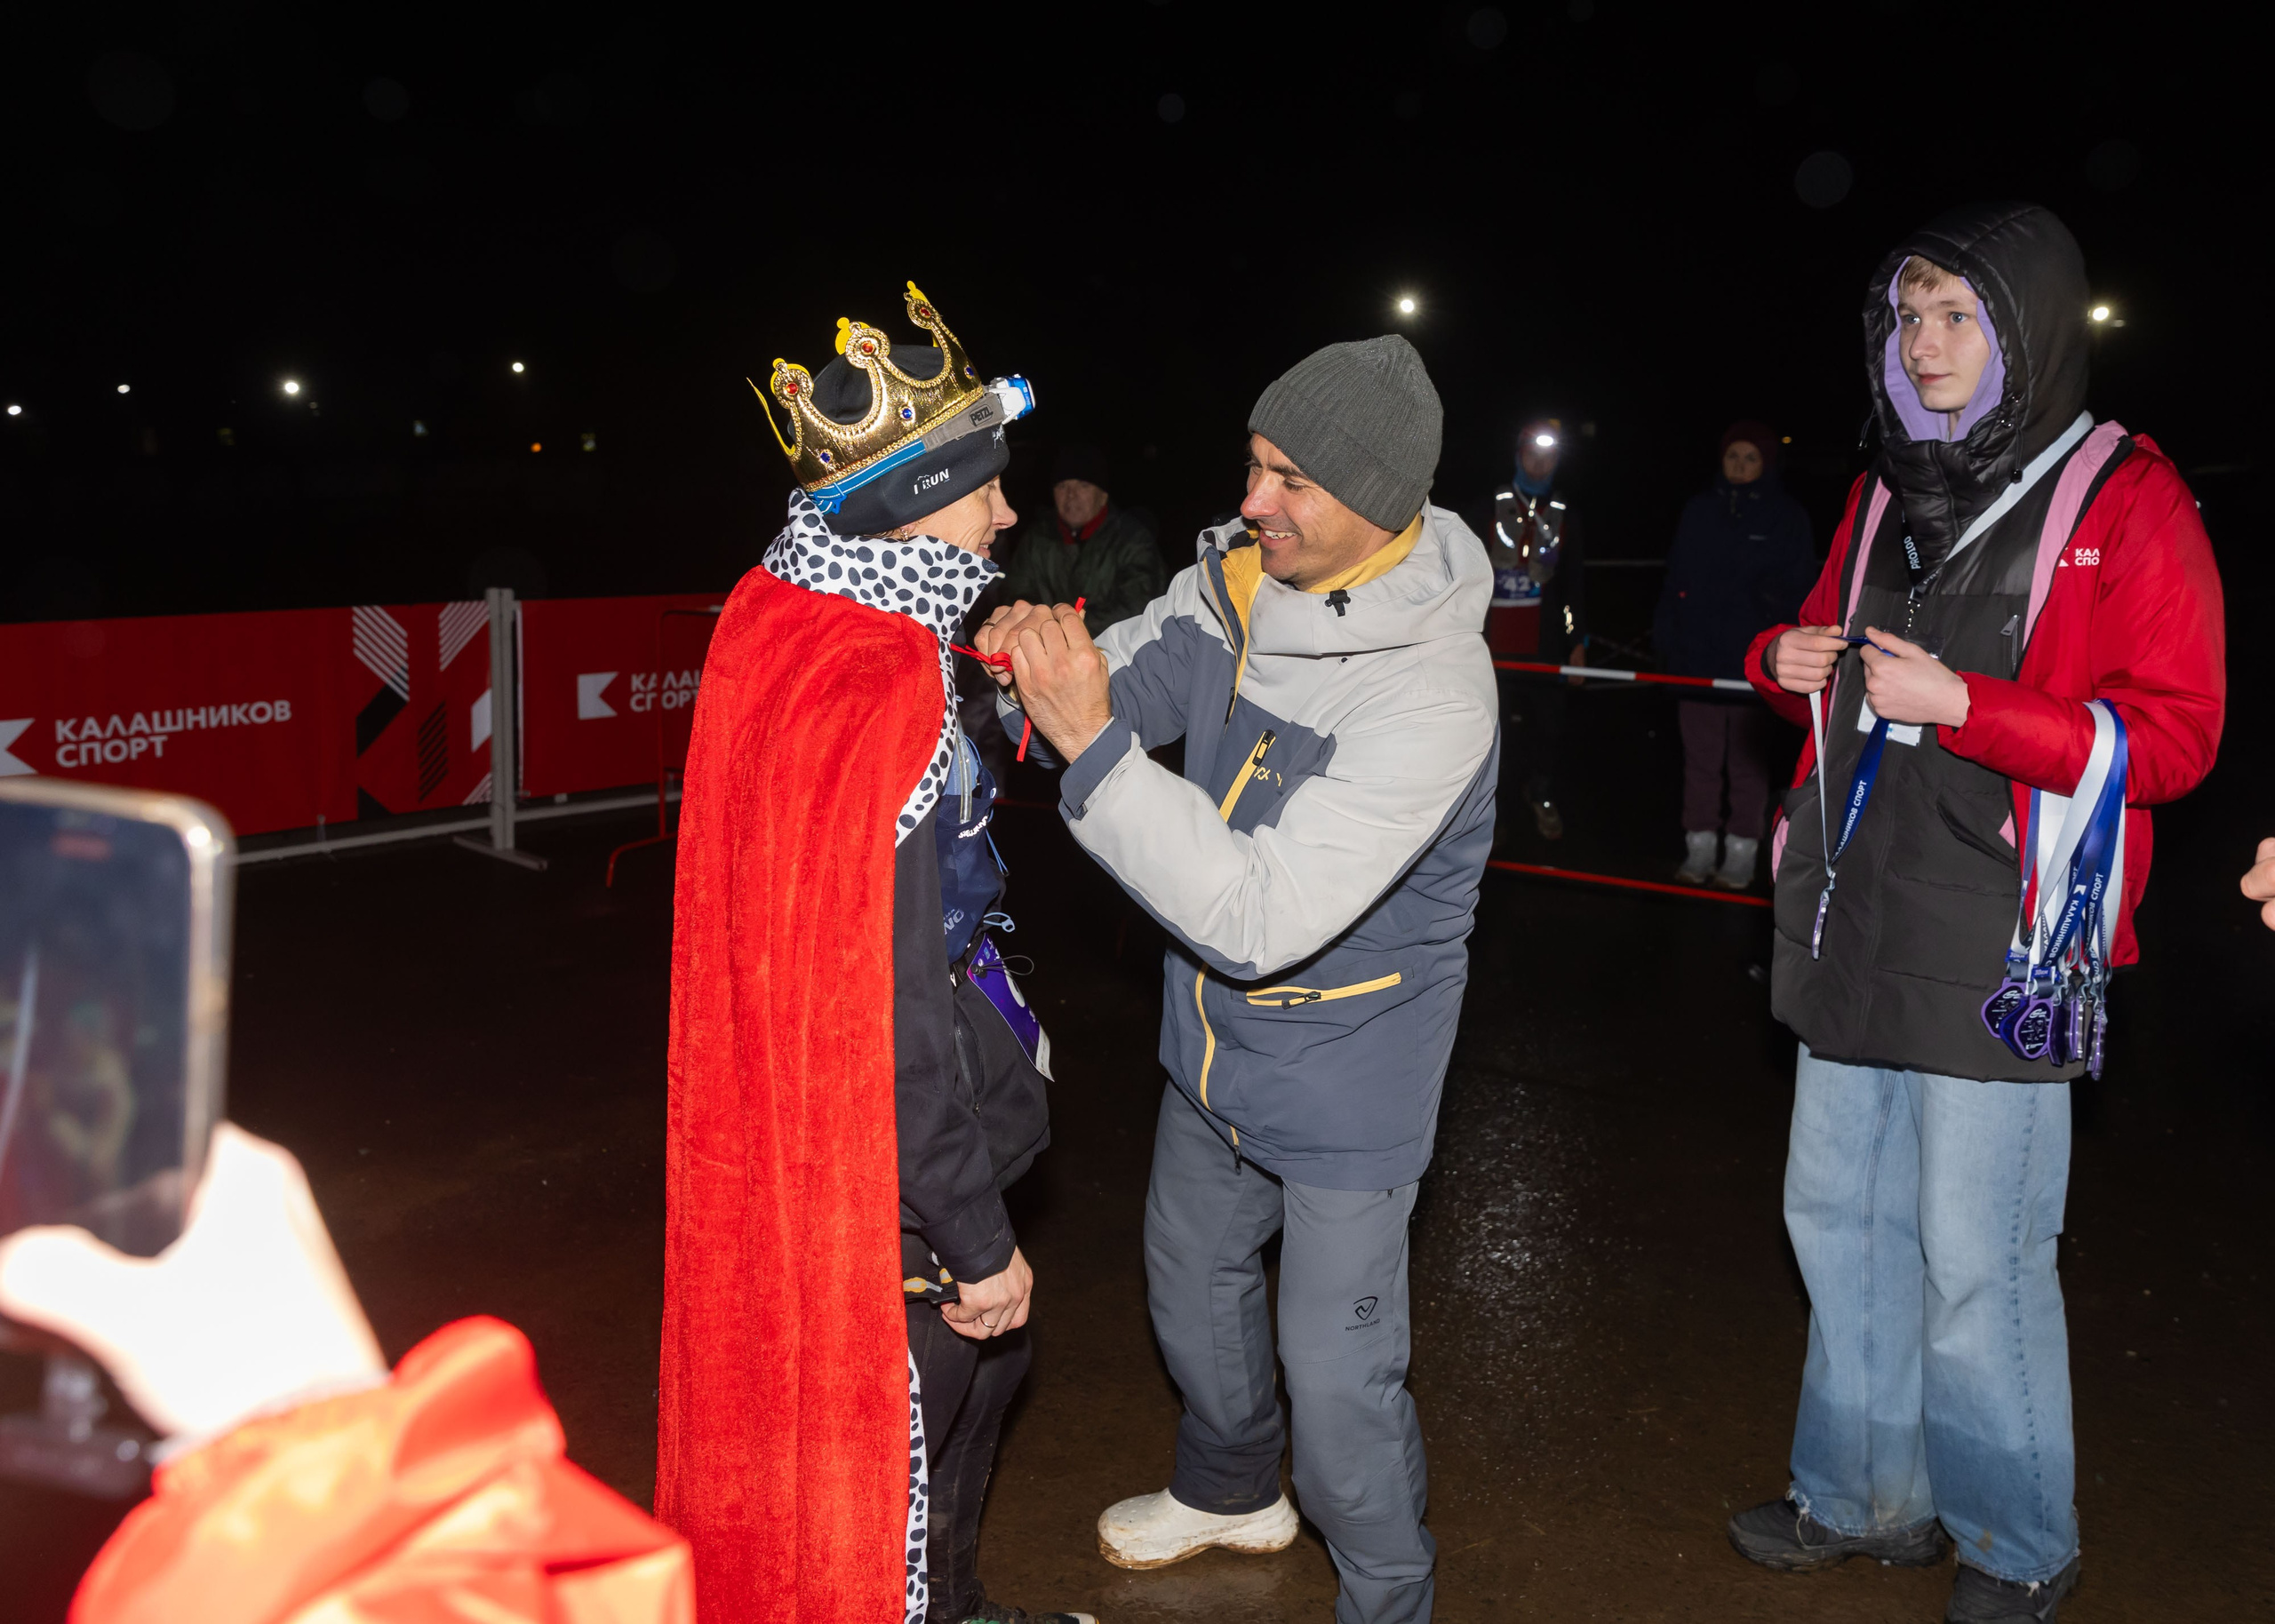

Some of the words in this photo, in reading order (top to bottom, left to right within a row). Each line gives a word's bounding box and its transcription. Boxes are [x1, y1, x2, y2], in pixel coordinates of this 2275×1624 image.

[970, 406, 993, 426] PETZL
[922, 468, 950, 490] RUN
[1904, 536, 1920, 569] PRO100
[55, 700, 291, 743] КАЛАШНИКОВ
[55, 735, 169, 768] СПОРТ
[1854, 780, 1867, 807] СПОРТ
[2090, 872, 2103, 900] СПОРТ
[2048, 899, 2079, 959] КАЛАШНИКОВ
[1345, 1318, 1380, 1331] NORTHLAND
